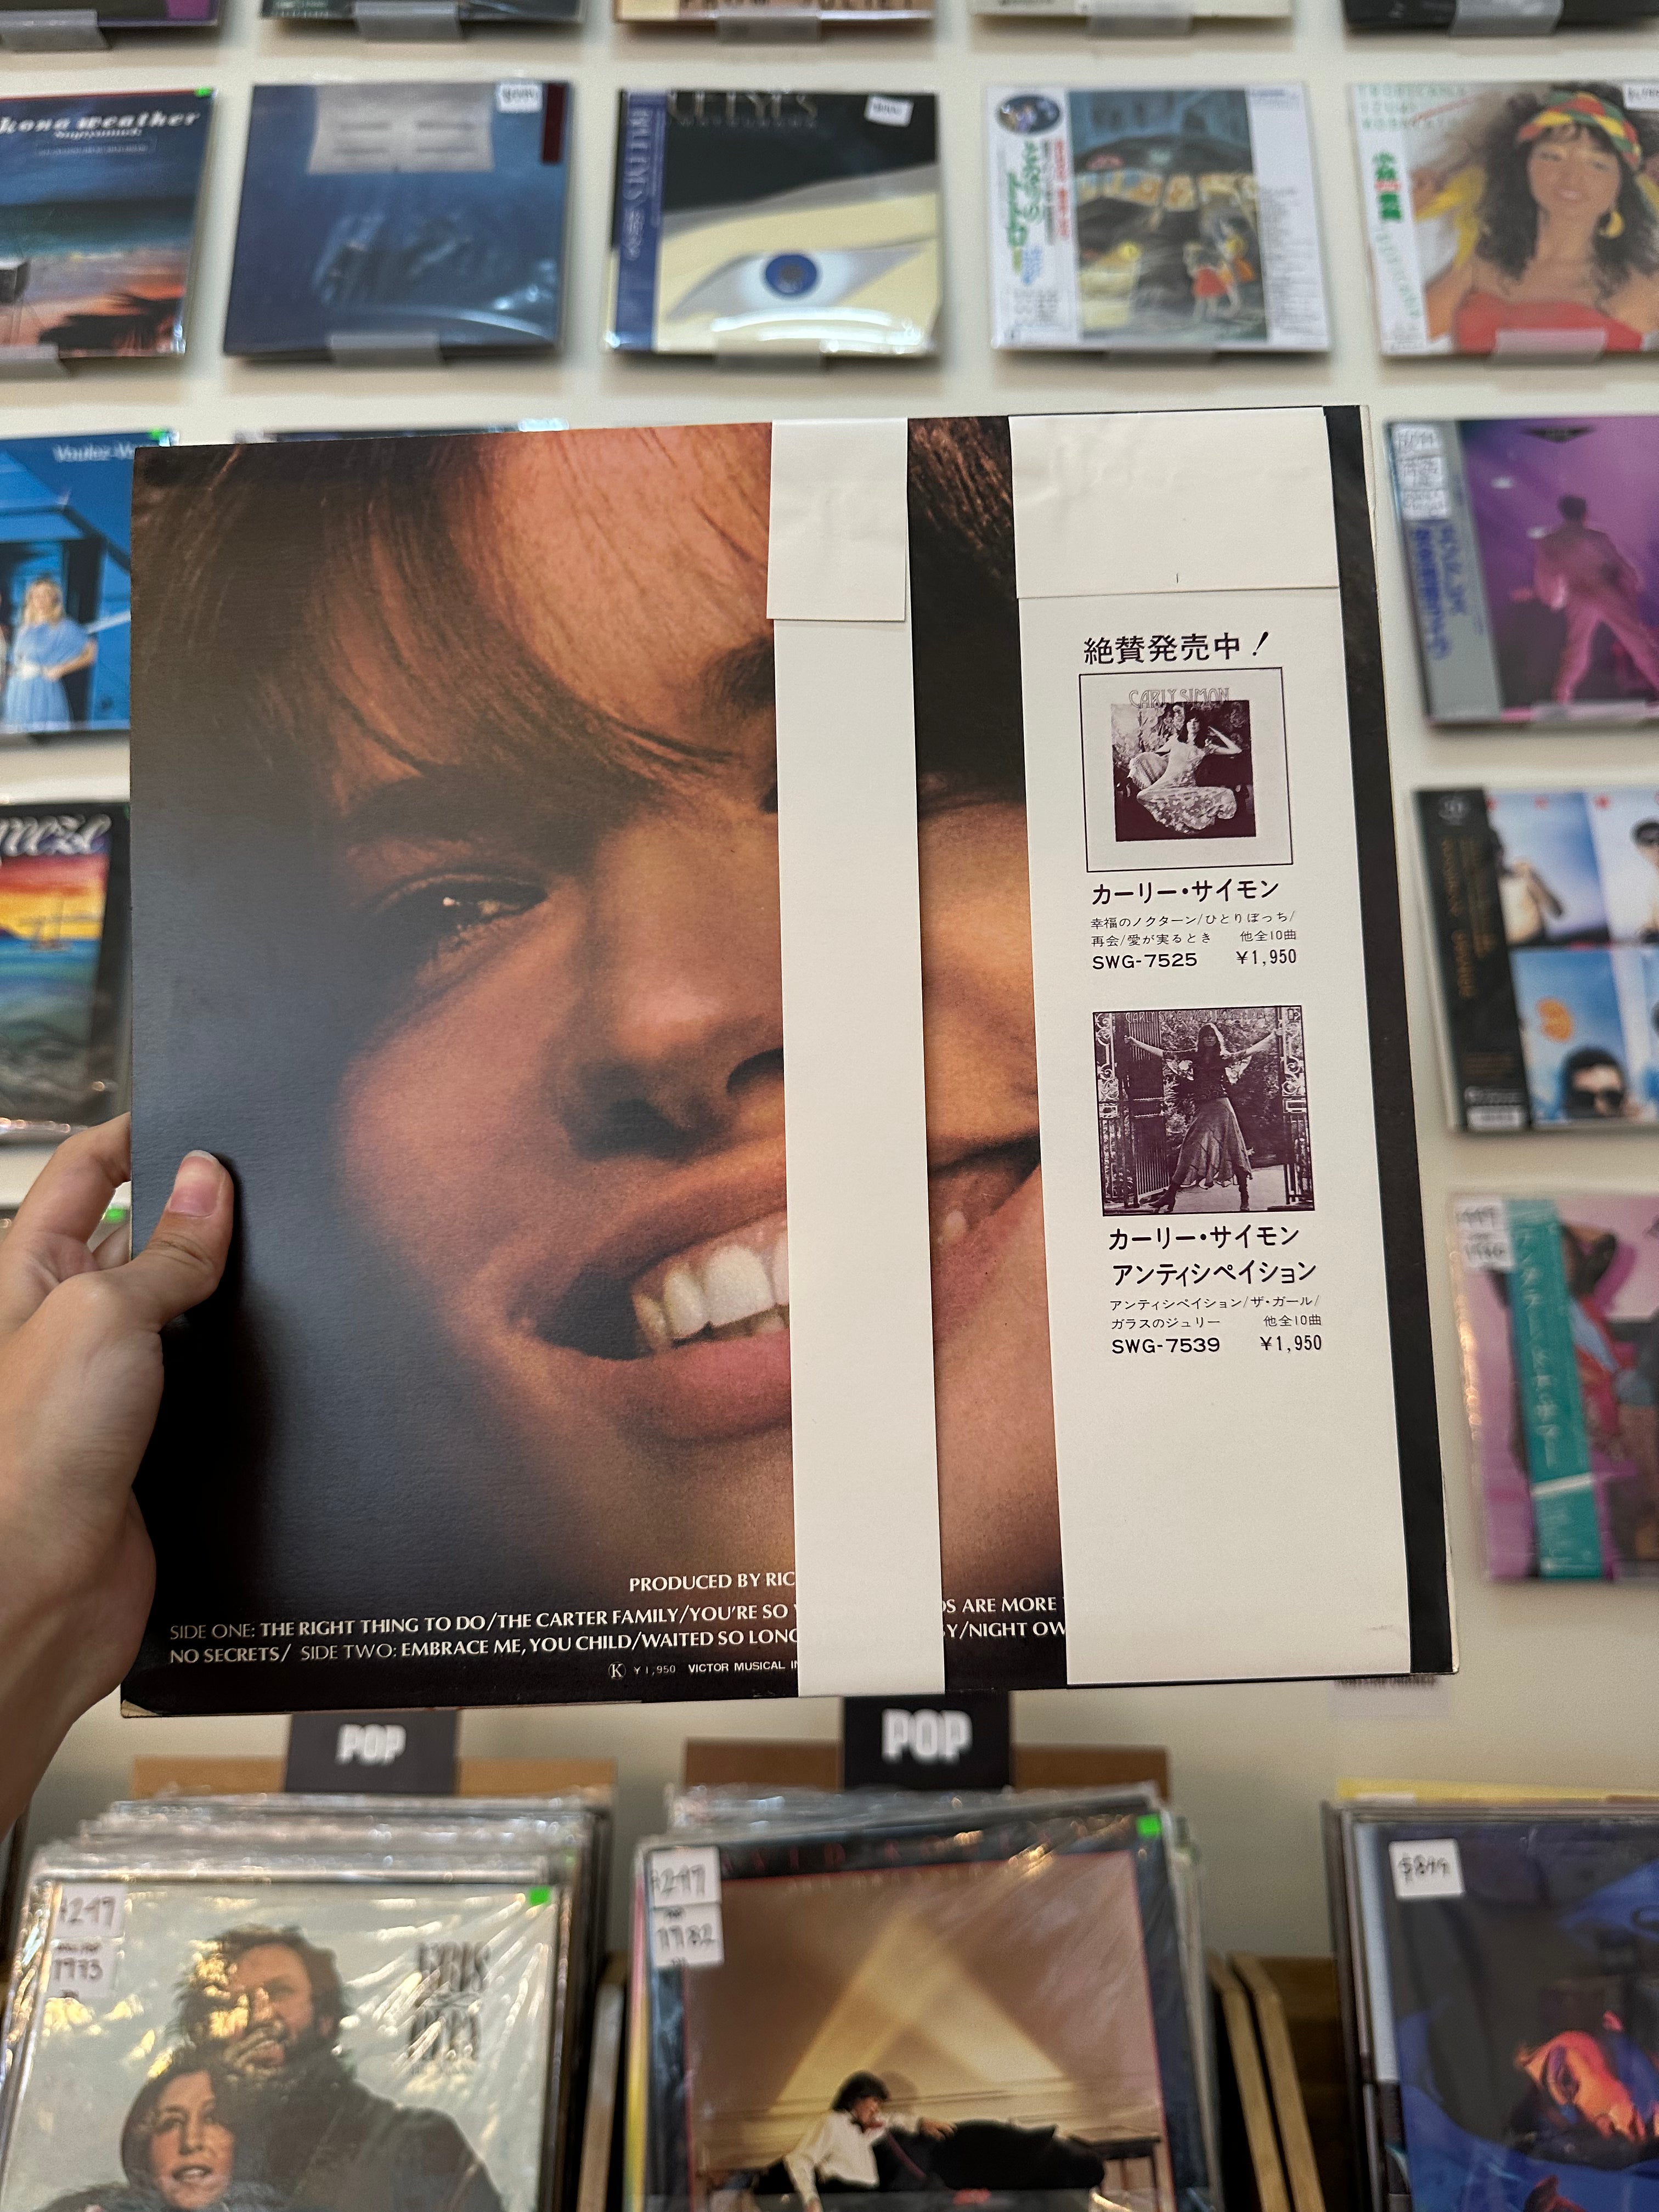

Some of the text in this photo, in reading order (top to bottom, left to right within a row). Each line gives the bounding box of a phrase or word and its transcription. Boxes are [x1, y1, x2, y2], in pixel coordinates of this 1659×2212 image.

[1128, 687, 1230, 709] CARLY SIMON
[1092, 878, 1279, 905] カーリー・サイモン
[1092, 949, 1297, 970] SWG-7525 ¥1,950
[1109, 1224, 1299, 1250] カーリー・サイモン
[1113, 1260, 1316, 1287] アンティシペイション
[1111, 1316, 1221, 1330] ガラスのジュリー
[1111, 1334, 1322, 1355] SWG-7539 ¥1,950
[630, 1573, 732, 1592] PRODUCED
[737, 1572, 761, 1588] BY
[962, 1598, 996, 1612] ARE
[1001, 1596, 1057, 1612] MORE
[170, 1624, 206, 1640] SIDE
[211, 1623, 255, 1639] ONE:
[260, 1622, 295, 1637] THE
[300, 1620, 356, 1635] RIGHT
[361, 1618, 419, 1634] THING
[425, 1617, 451, 1632] TO
[536, 1610, 607, 1627] CARTER
[763, 1604, 788, 1619] SO
[170, 1649, 199, 1663] NO
[301, 1645, 338, 1661] SIDE
[343, 1644, 396, 1658] TWO:
[402, 1640, 488, 1657] EMBRACE
[529, 1637, 572, 1652] YOU
[718, 1630, 744, 1645] SO
[688, 1662, 729, 1673] VICTOR
[734, 1661, 786, 1672] MUSICAL
[336, 1724, 407, 1765] POP
[882, 1708, 973, 1765] POP
